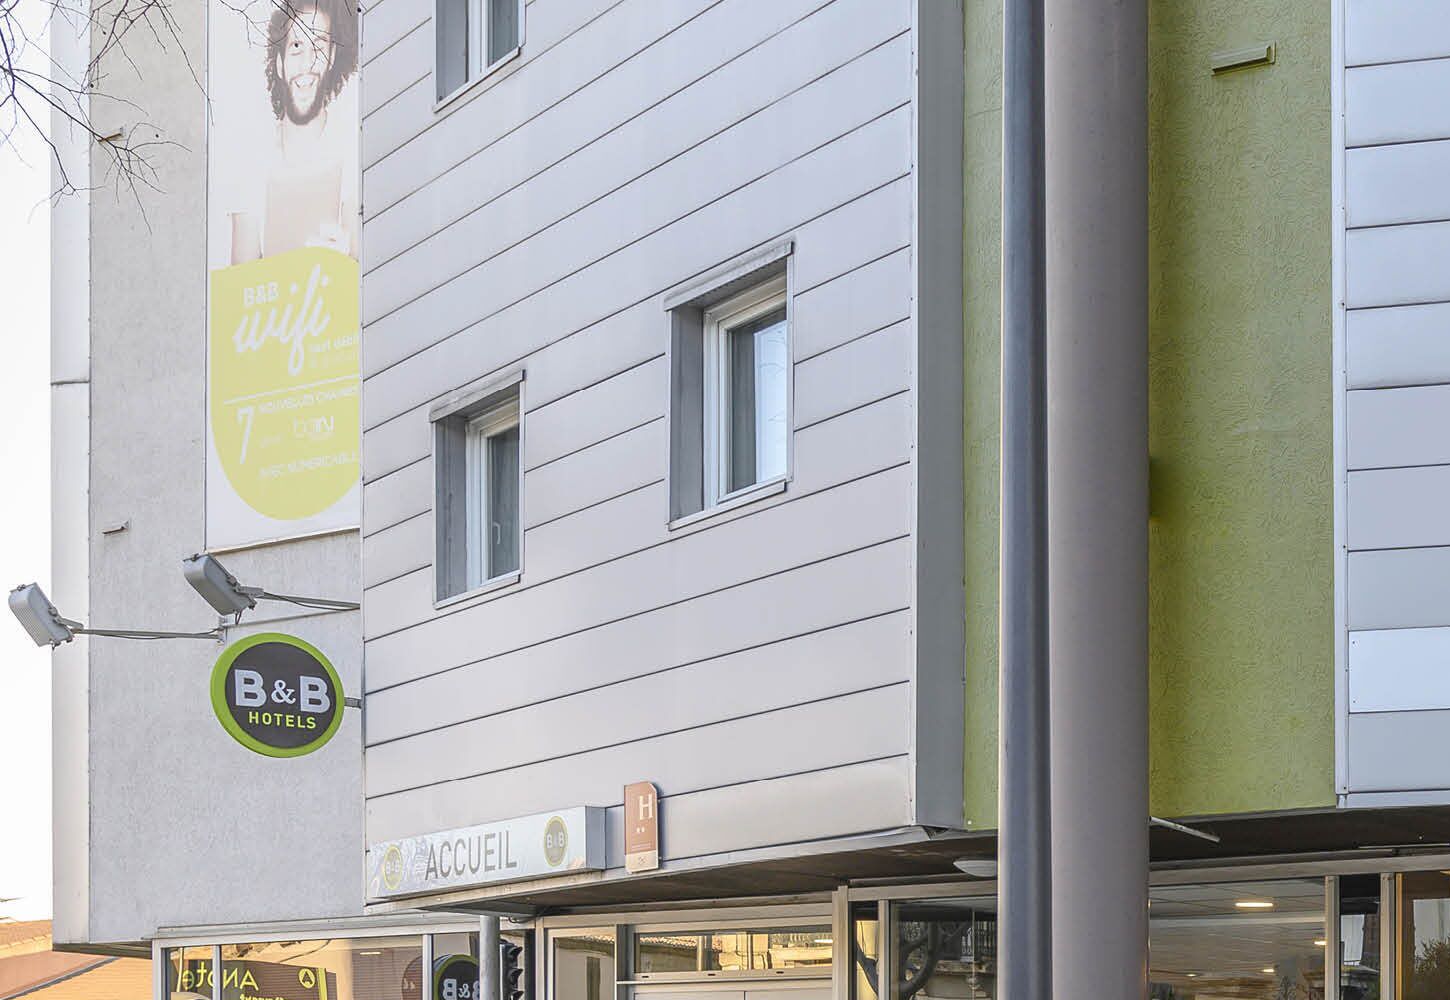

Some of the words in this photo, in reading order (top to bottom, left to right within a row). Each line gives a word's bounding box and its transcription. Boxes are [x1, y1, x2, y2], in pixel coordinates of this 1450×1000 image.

[232, 264, 331, 377] wifi
[235, 669, 331, 714] B&B
[248, 711, 317, 729] HOTELS
[639, 793, 654, 821] H
[425, 829, 518, 881] ACCUEIL
